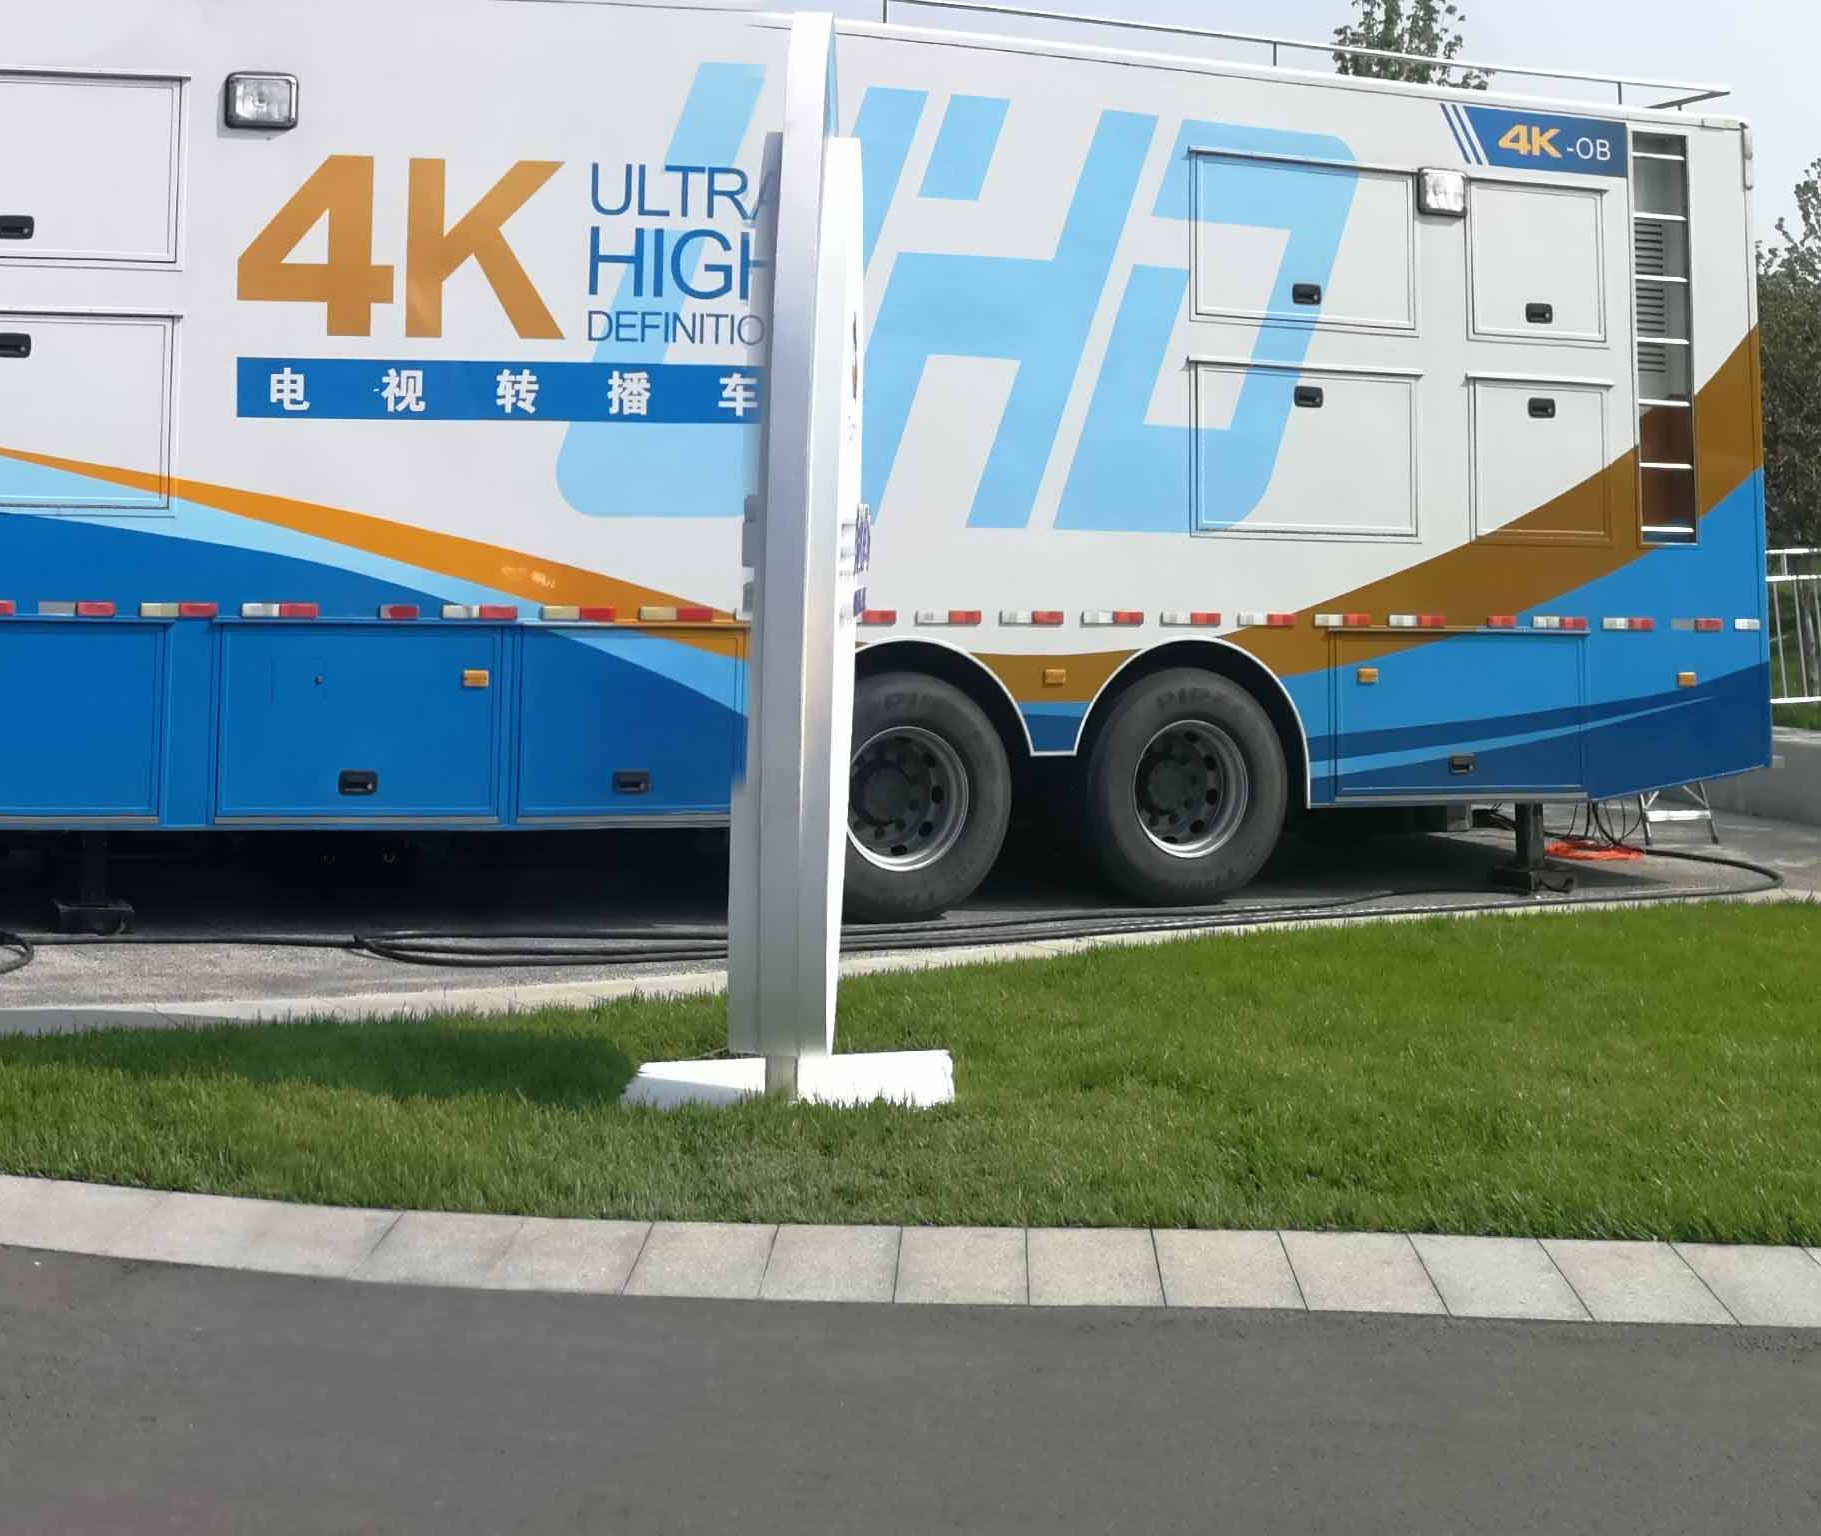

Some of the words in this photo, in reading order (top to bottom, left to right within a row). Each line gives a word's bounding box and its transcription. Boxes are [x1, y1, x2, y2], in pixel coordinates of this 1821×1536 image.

[237, 154, 566, 340] 4K
[269, 368, 759, 417] 电视转播车
